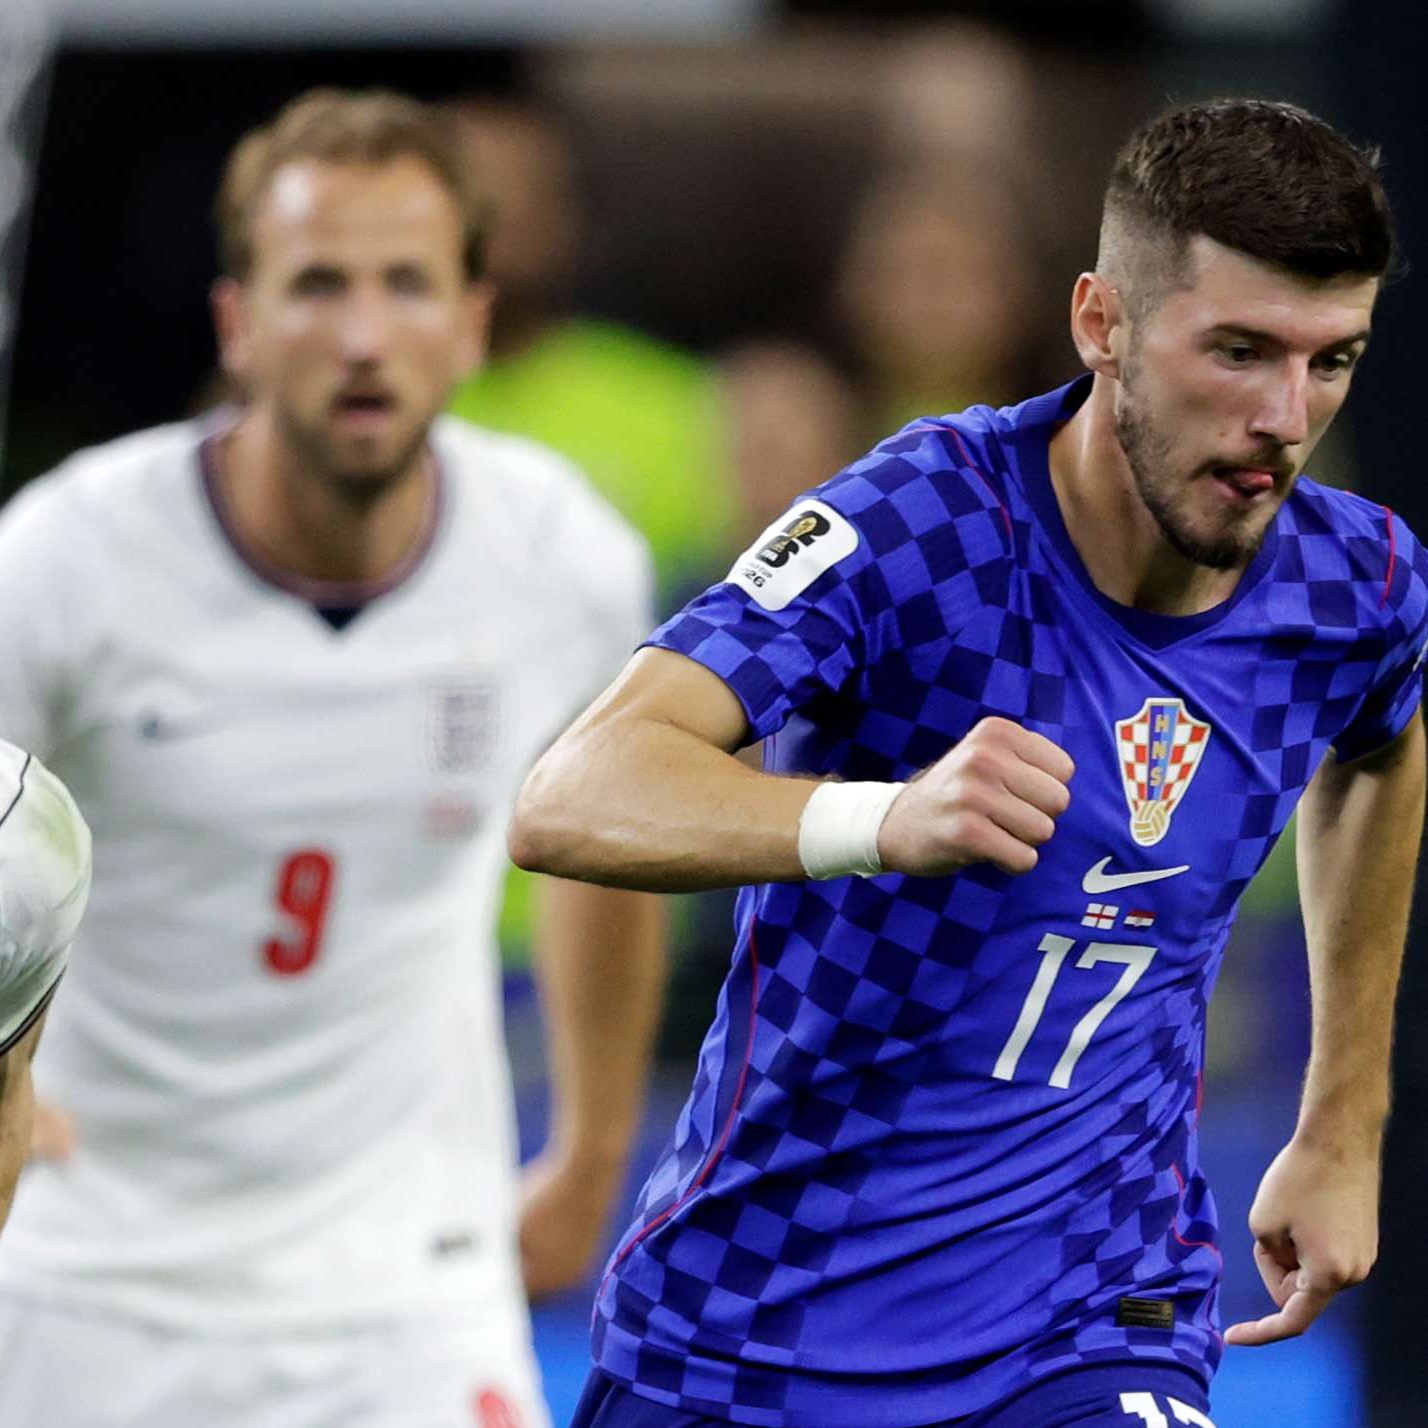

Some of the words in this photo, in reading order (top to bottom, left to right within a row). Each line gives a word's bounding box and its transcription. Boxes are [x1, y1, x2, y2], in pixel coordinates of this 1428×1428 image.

[1150, 714, 1170, 787] HNS
[263, 848, 334, 976] 9
[991, 932, 1159, 1090] 17
